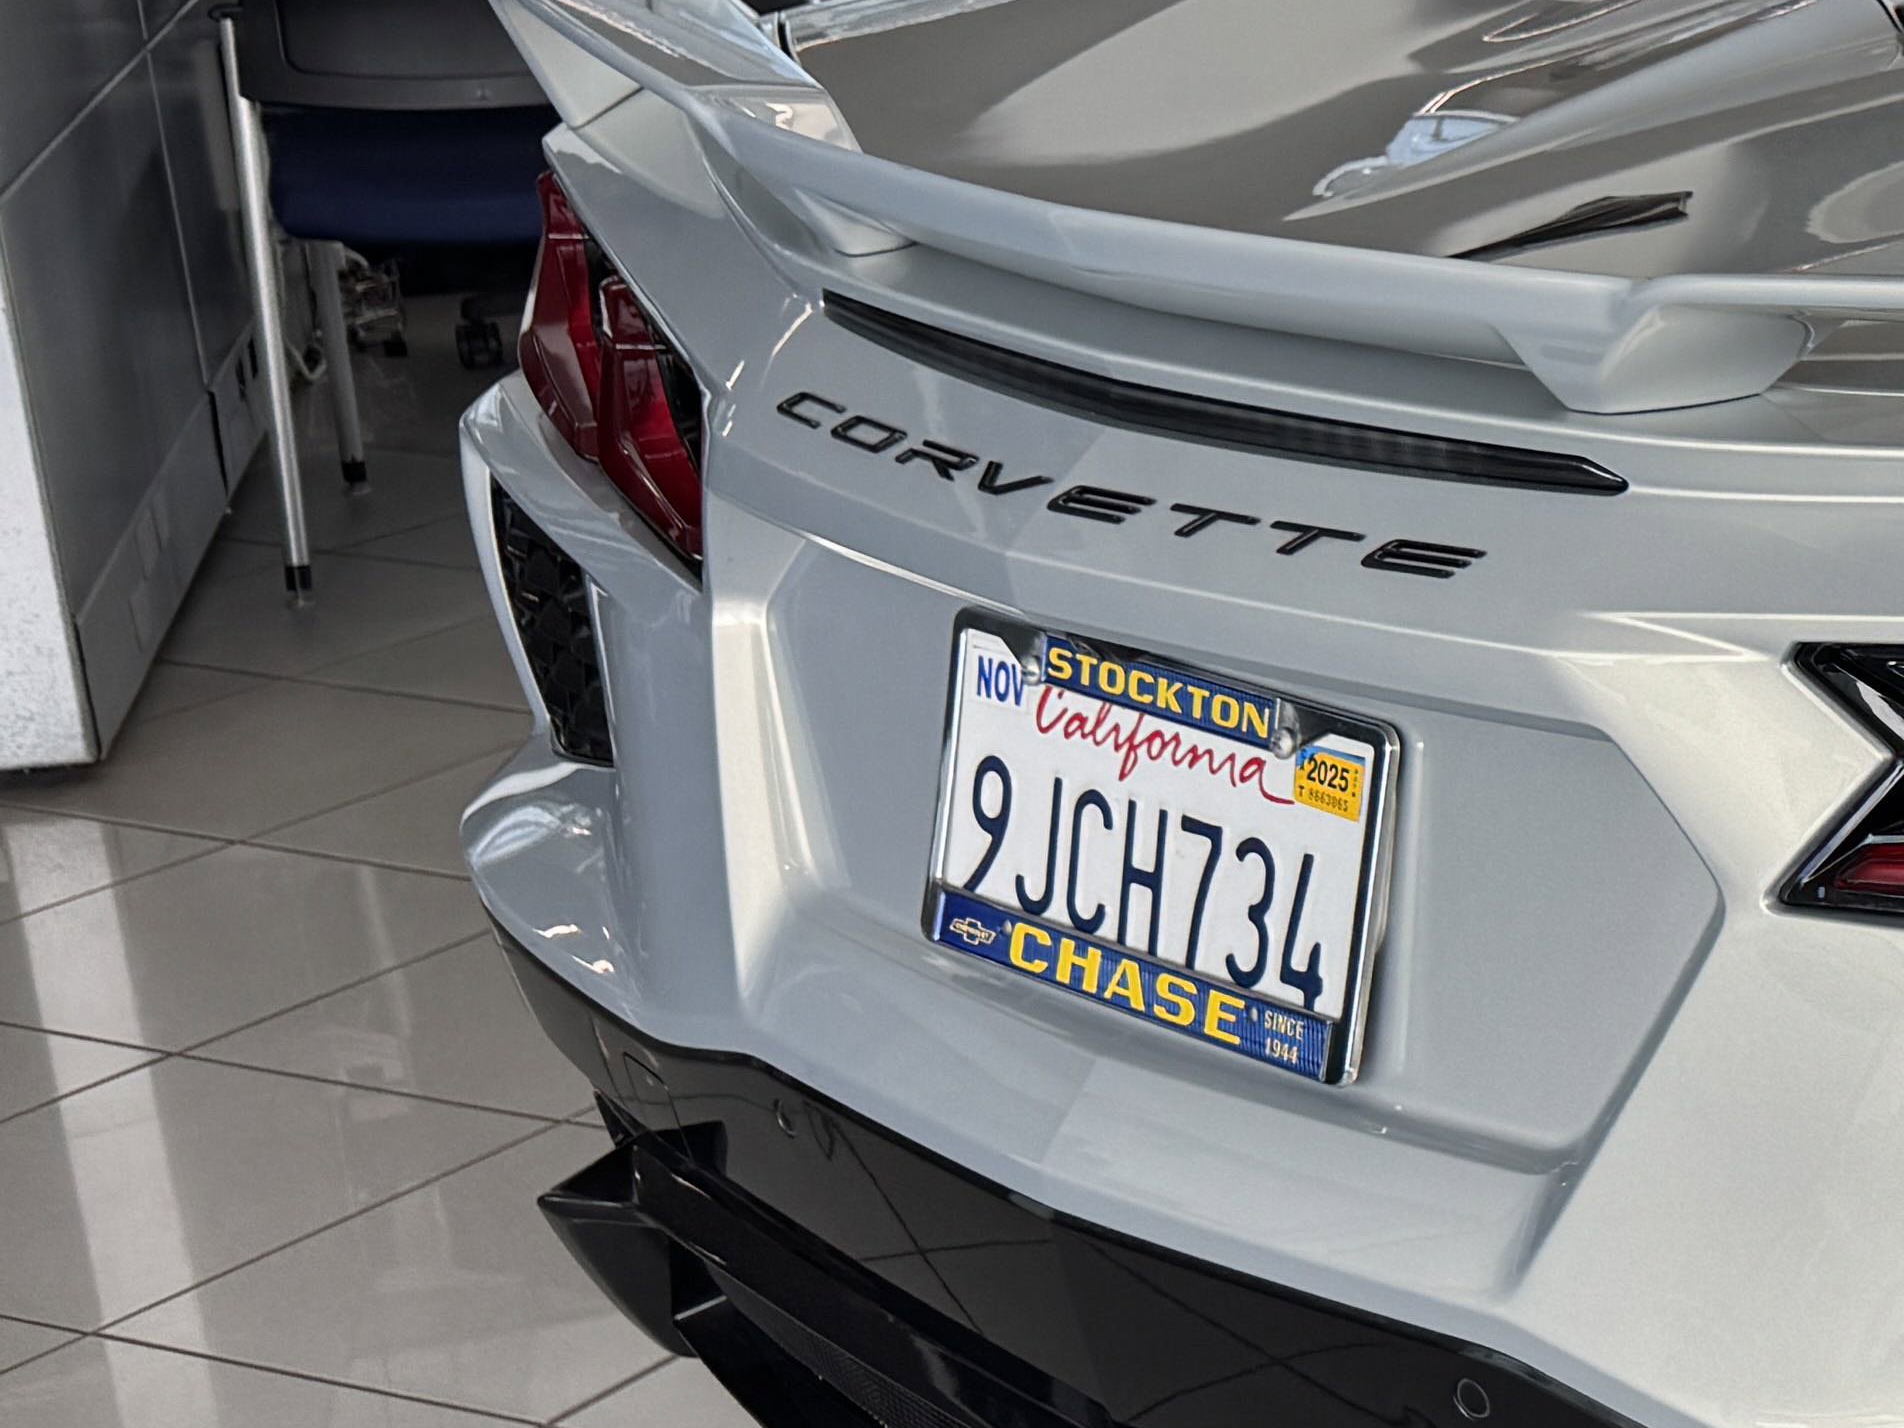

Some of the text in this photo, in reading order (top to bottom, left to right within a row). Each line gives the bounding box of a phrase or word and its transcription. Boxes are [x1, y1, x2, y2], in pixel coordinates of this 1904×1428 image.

[776, 391, 1486, 579] CORVETTE
[976, 655, 1024, 707] NOV
[1047, 646, 1273, 740] STOCKTON
[1035, 685, 1295, 805] California
[1306, 755, 1349, 793] 2025
[964, 754, 1324, 1009] 9JCH734
[1009, 921, 1246, 1046] CHASE
[1264, 1010, 1304, 1042] SINCE
[1265, 1037, 1298, 1064] 1944
